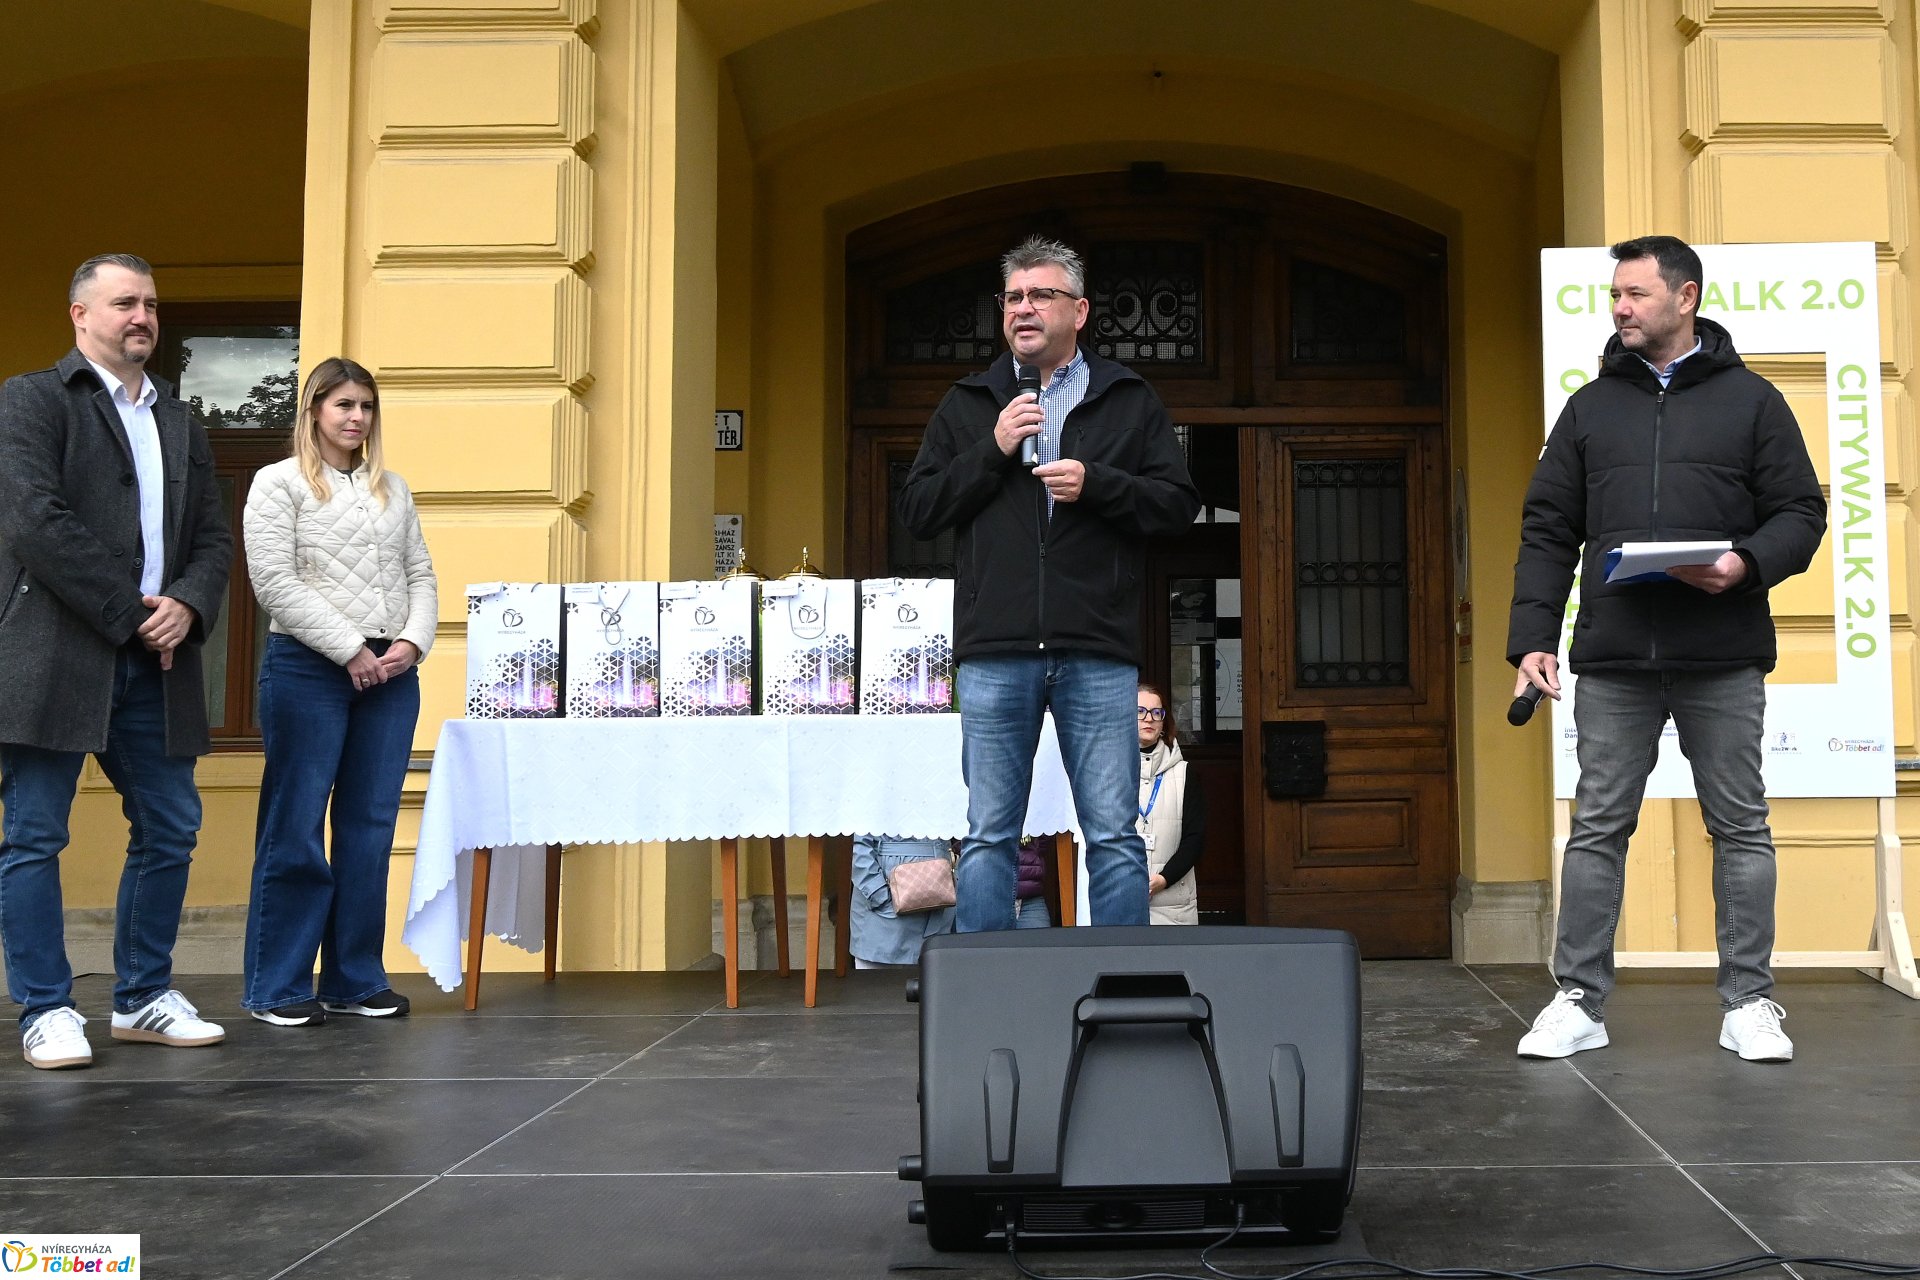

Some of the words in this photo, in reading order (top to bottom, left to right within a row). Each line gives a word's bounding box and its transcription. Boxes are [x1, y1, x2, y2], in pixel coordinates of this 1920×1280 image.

[1801, 279, 1865, 310] 2.0
[718, 426, 737, 446] TÉR
[1837, 364, 1874, 583] CITYWALK
[1845, 597, 1877, 659] 2.0
